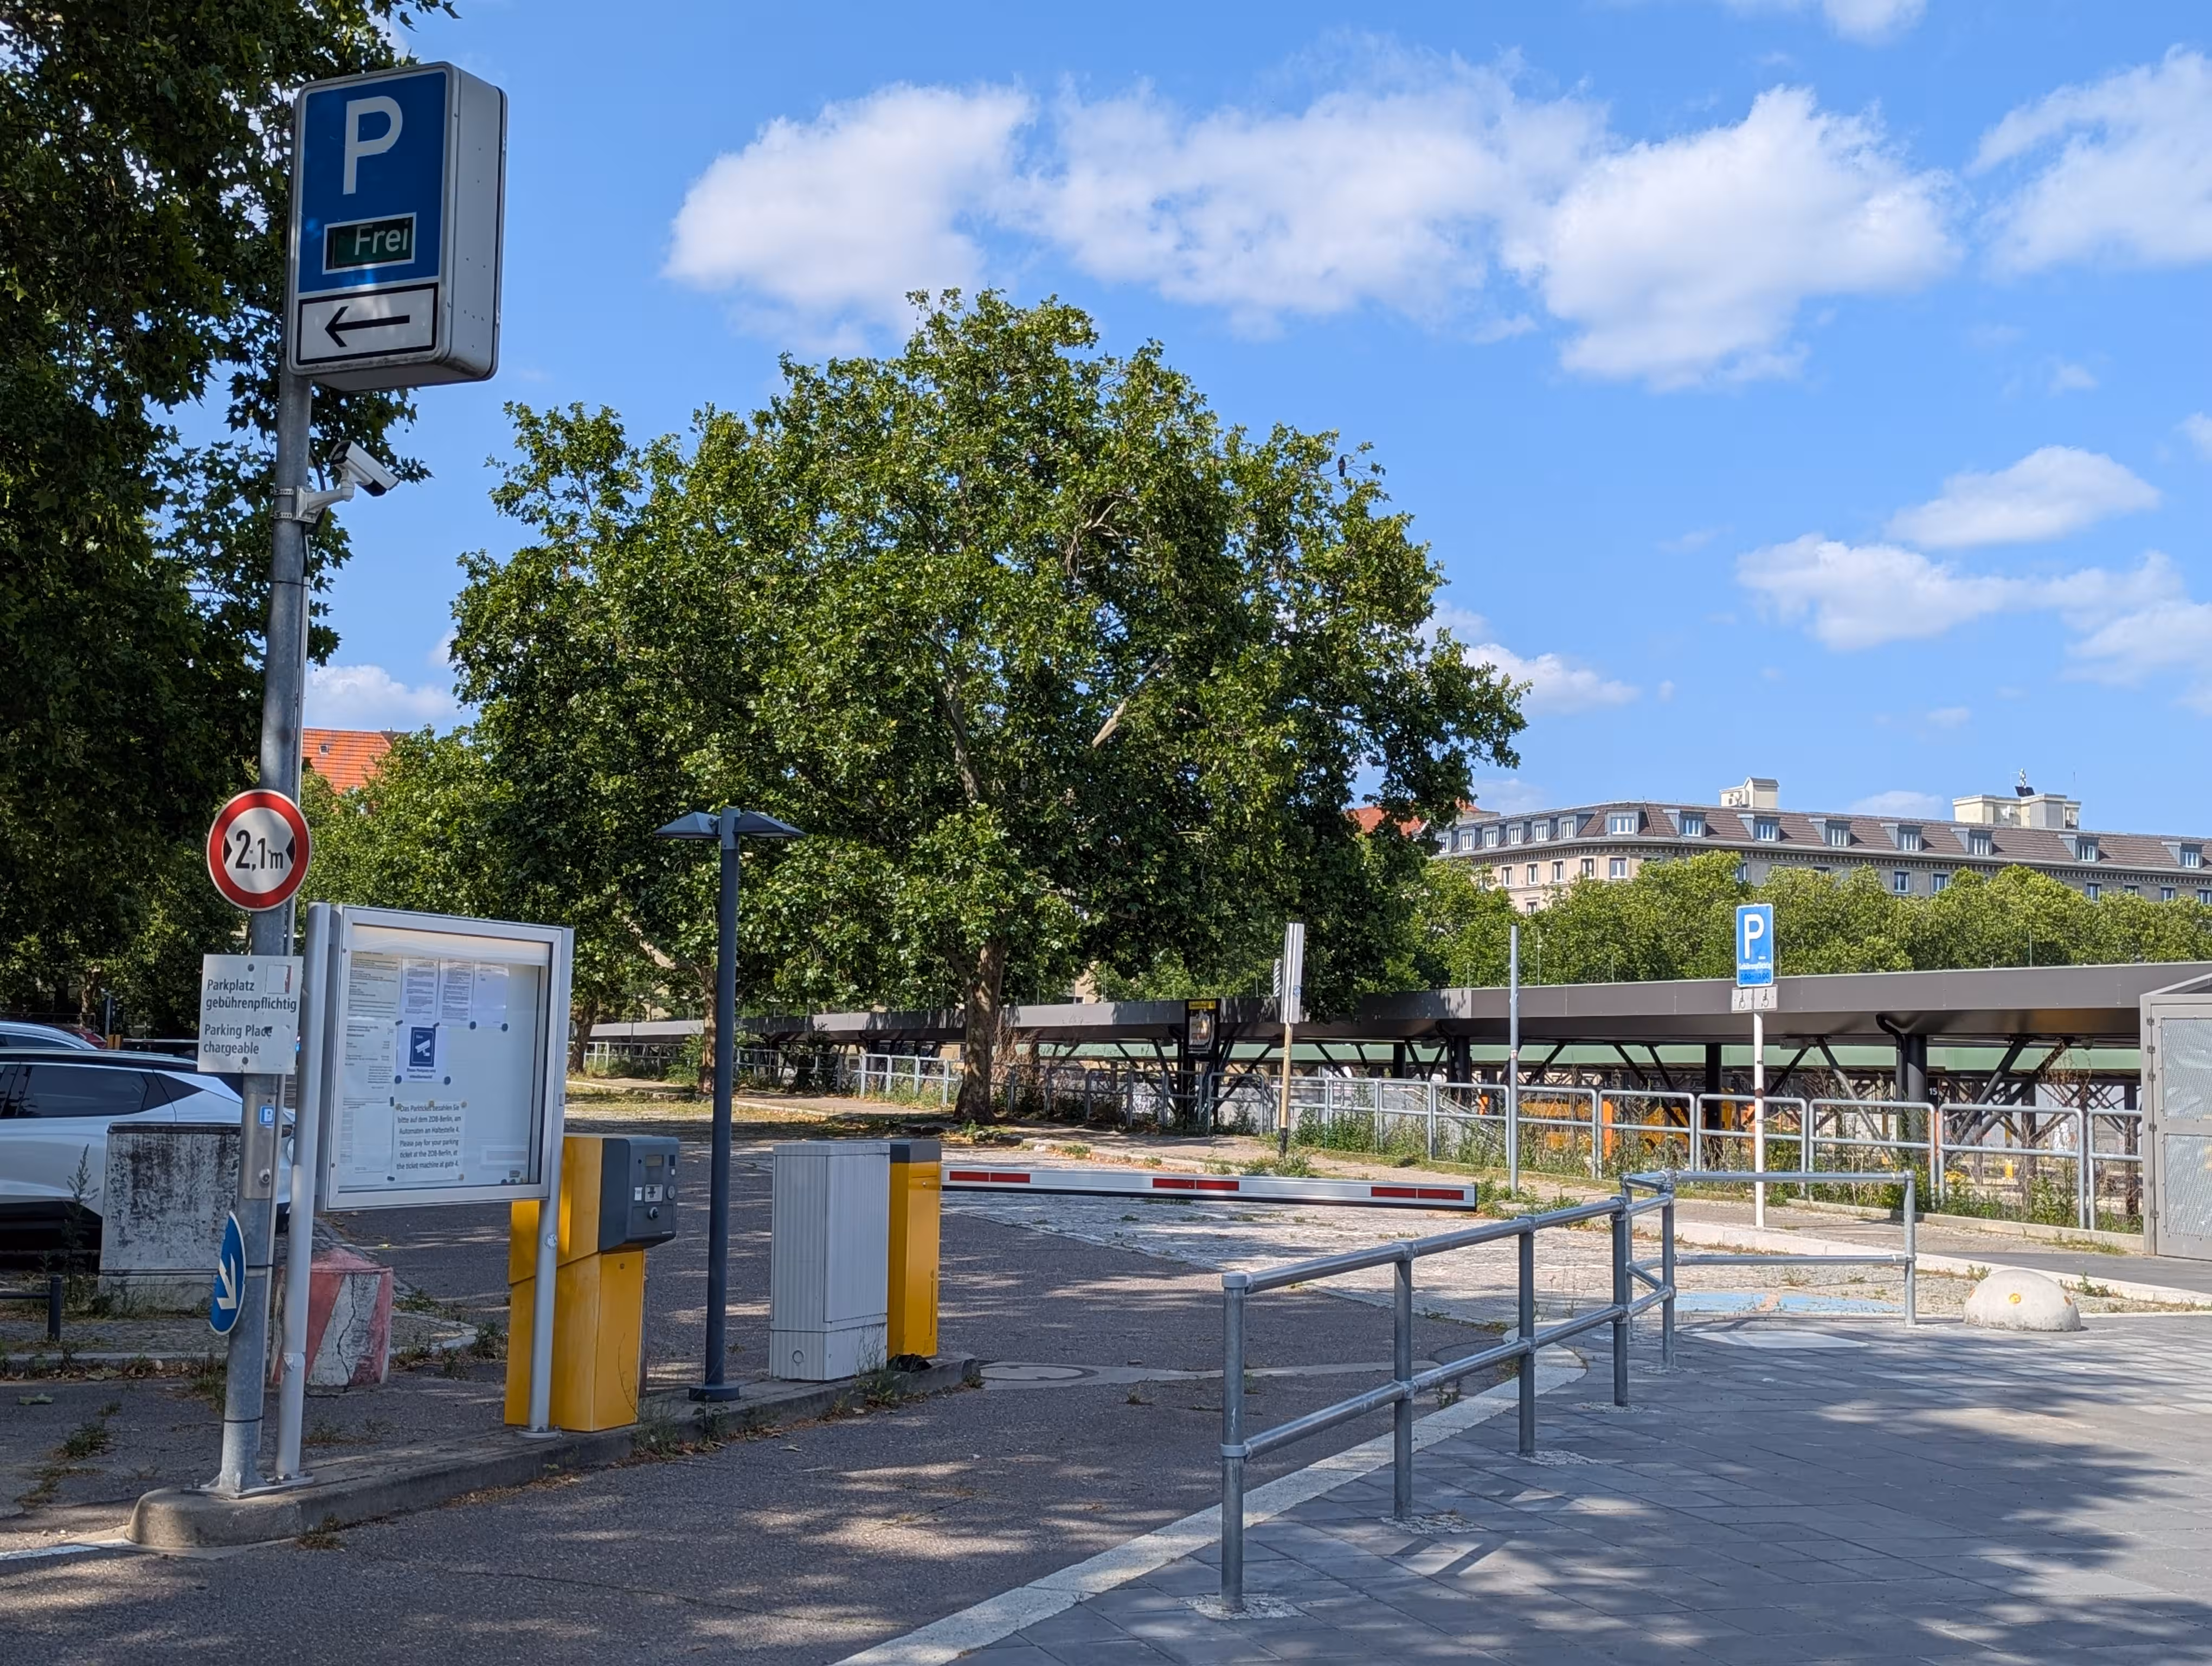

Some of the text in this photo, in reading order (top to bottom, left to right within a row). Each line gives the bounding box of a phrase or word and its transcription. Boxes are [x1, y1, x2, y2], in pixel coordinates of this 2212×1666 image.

[342, 95, 403, 195] P
[355, 220, 409, 256] Frei
[1744, 914, 1765, 959] P
[207, 978, 255, 994] Parkplatz
[205, 996, 297, 1013] gebührenpflichtig
[204, 1023, 242, 1039] Parking
[203, 1041, 259, 1056] chargeable
[1928, 1087, 1938, 1095] 15
